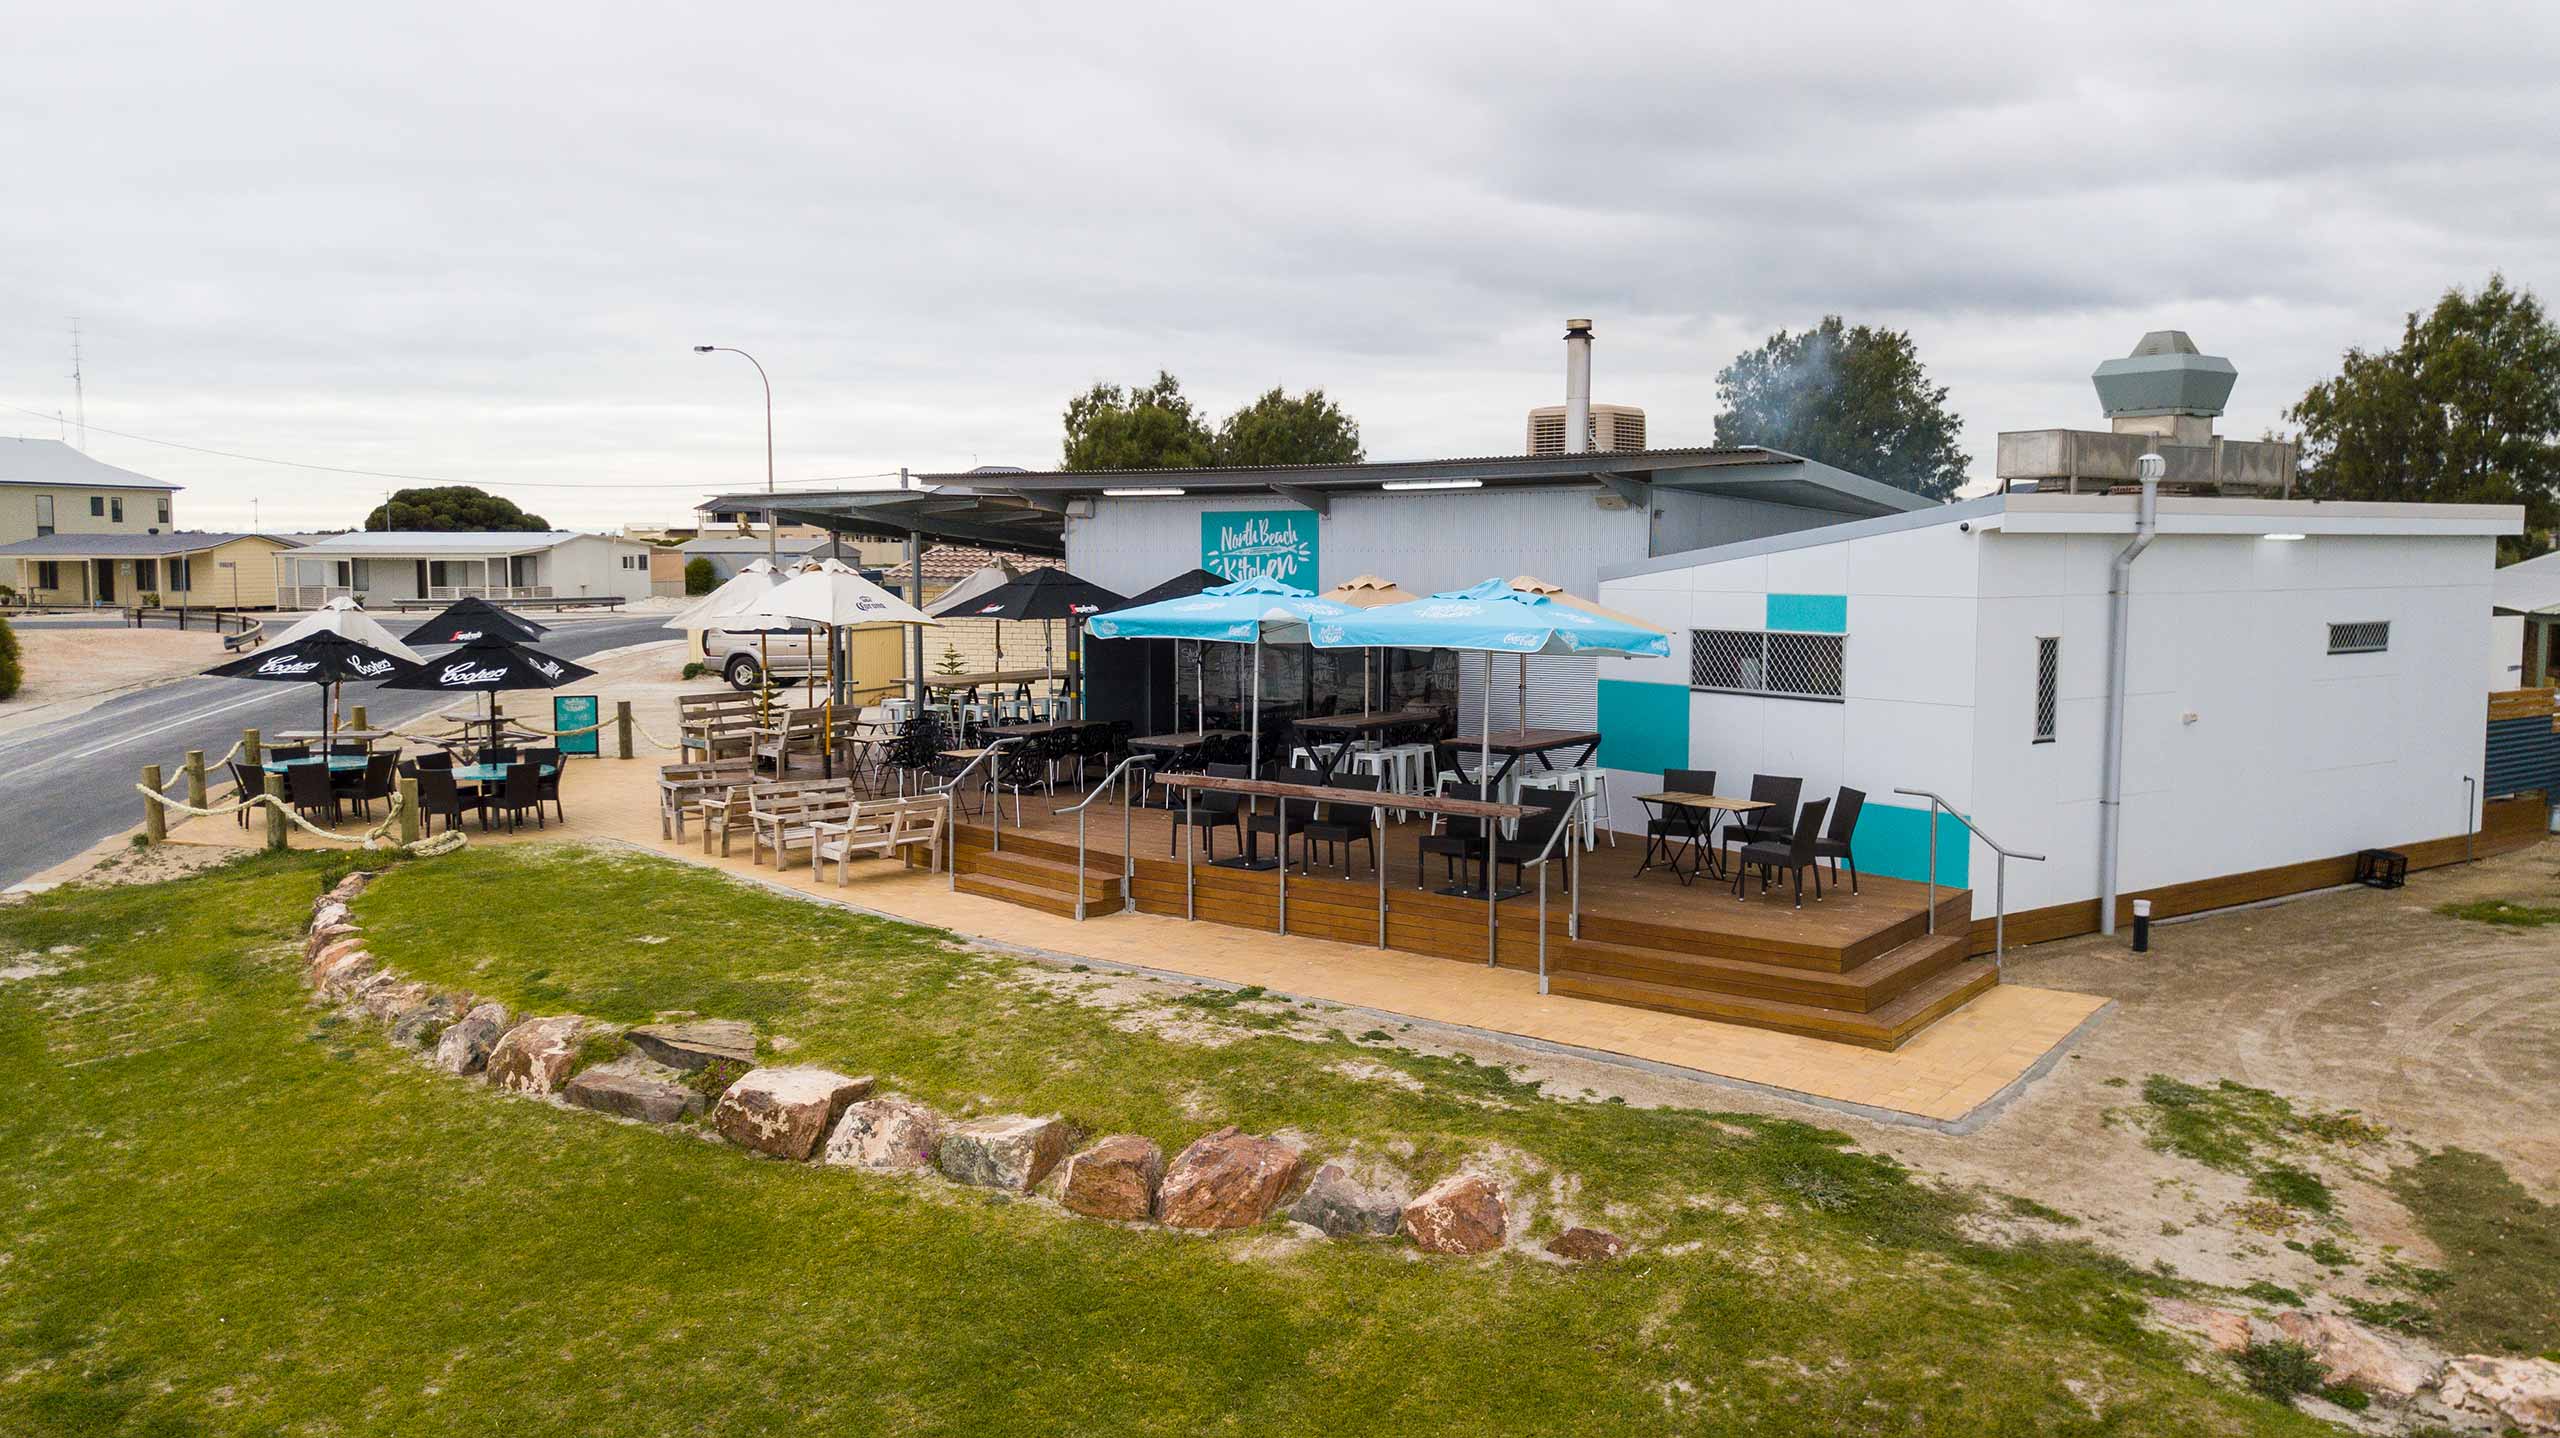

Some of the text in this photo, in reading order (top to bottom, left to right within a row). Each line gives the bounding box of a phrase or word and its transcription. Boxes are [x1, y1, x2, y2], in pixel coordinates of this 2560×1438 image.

[1221, 518, 1298, 551] North Beach
[258, 654, 320, 674] Coopers
[346, 655, 395, 676] Coopers
[440, 662, 508, 686] Coopers
